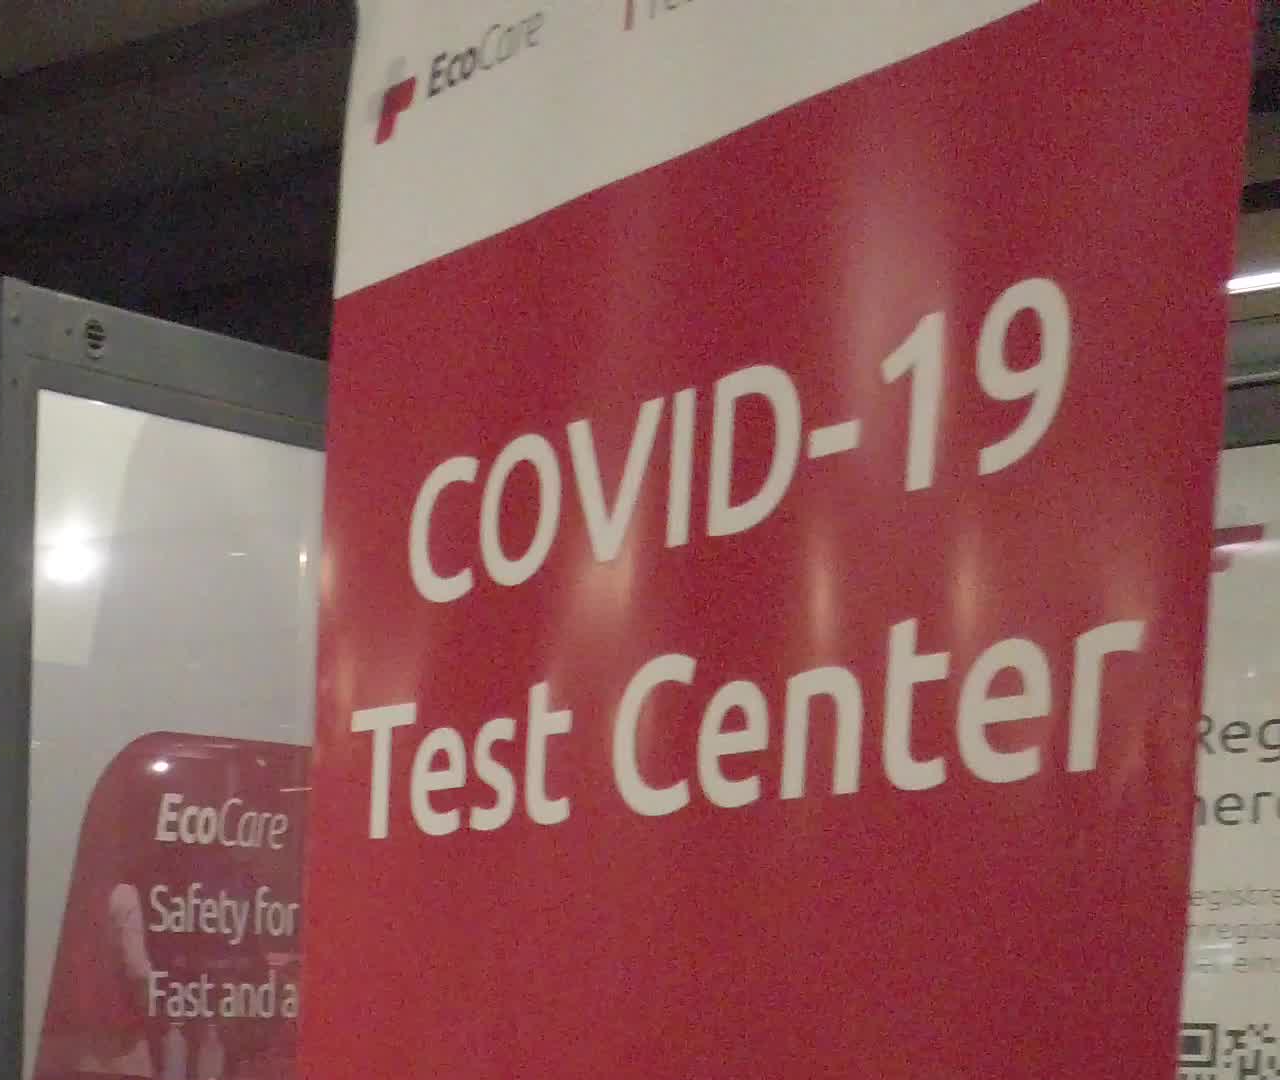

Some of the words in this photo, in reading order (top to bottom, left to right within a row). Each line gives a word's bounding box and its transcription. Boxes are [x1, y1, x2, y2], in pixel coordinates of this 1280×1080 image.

[426, 10, 544, 98] EcoCare
[408, 276, 1073, 604] COVID-19
[351, 681, 575, 839] Test
[611, 616, 1147, 817] Center
[154, 793, 289, 850] EcoCare
[148, 881, 249, 946] Safety
[254, 885, 299, 937] for
[147, 970, 214, 1018] Fast
[222, 979, 276, 1018] and
